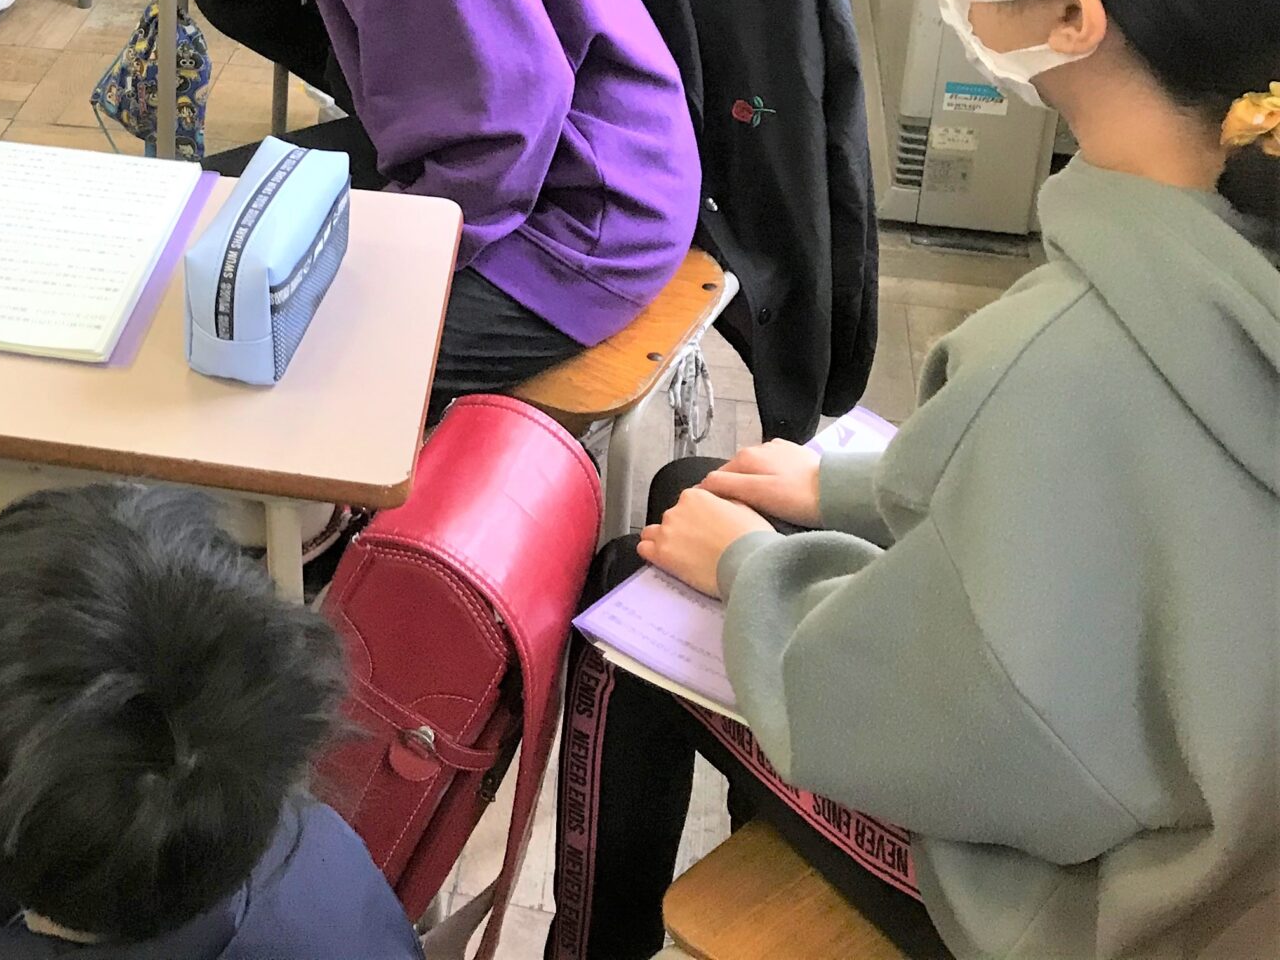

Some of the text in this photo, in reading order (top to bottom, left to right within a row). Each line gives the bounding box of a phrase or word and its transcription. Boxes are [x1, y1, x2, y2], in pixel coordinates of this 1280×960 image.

[222, 250, 239, 279] SWUM
[231, 226, 249, 249] SHARK
[575, 671, 601, 719] ENDS
[567, 726, 590, 836] NEVER ENDS
[812, 792, 910, 878] NEVER ENDS
[558, 845, 584, 956] NEVER ENDS
